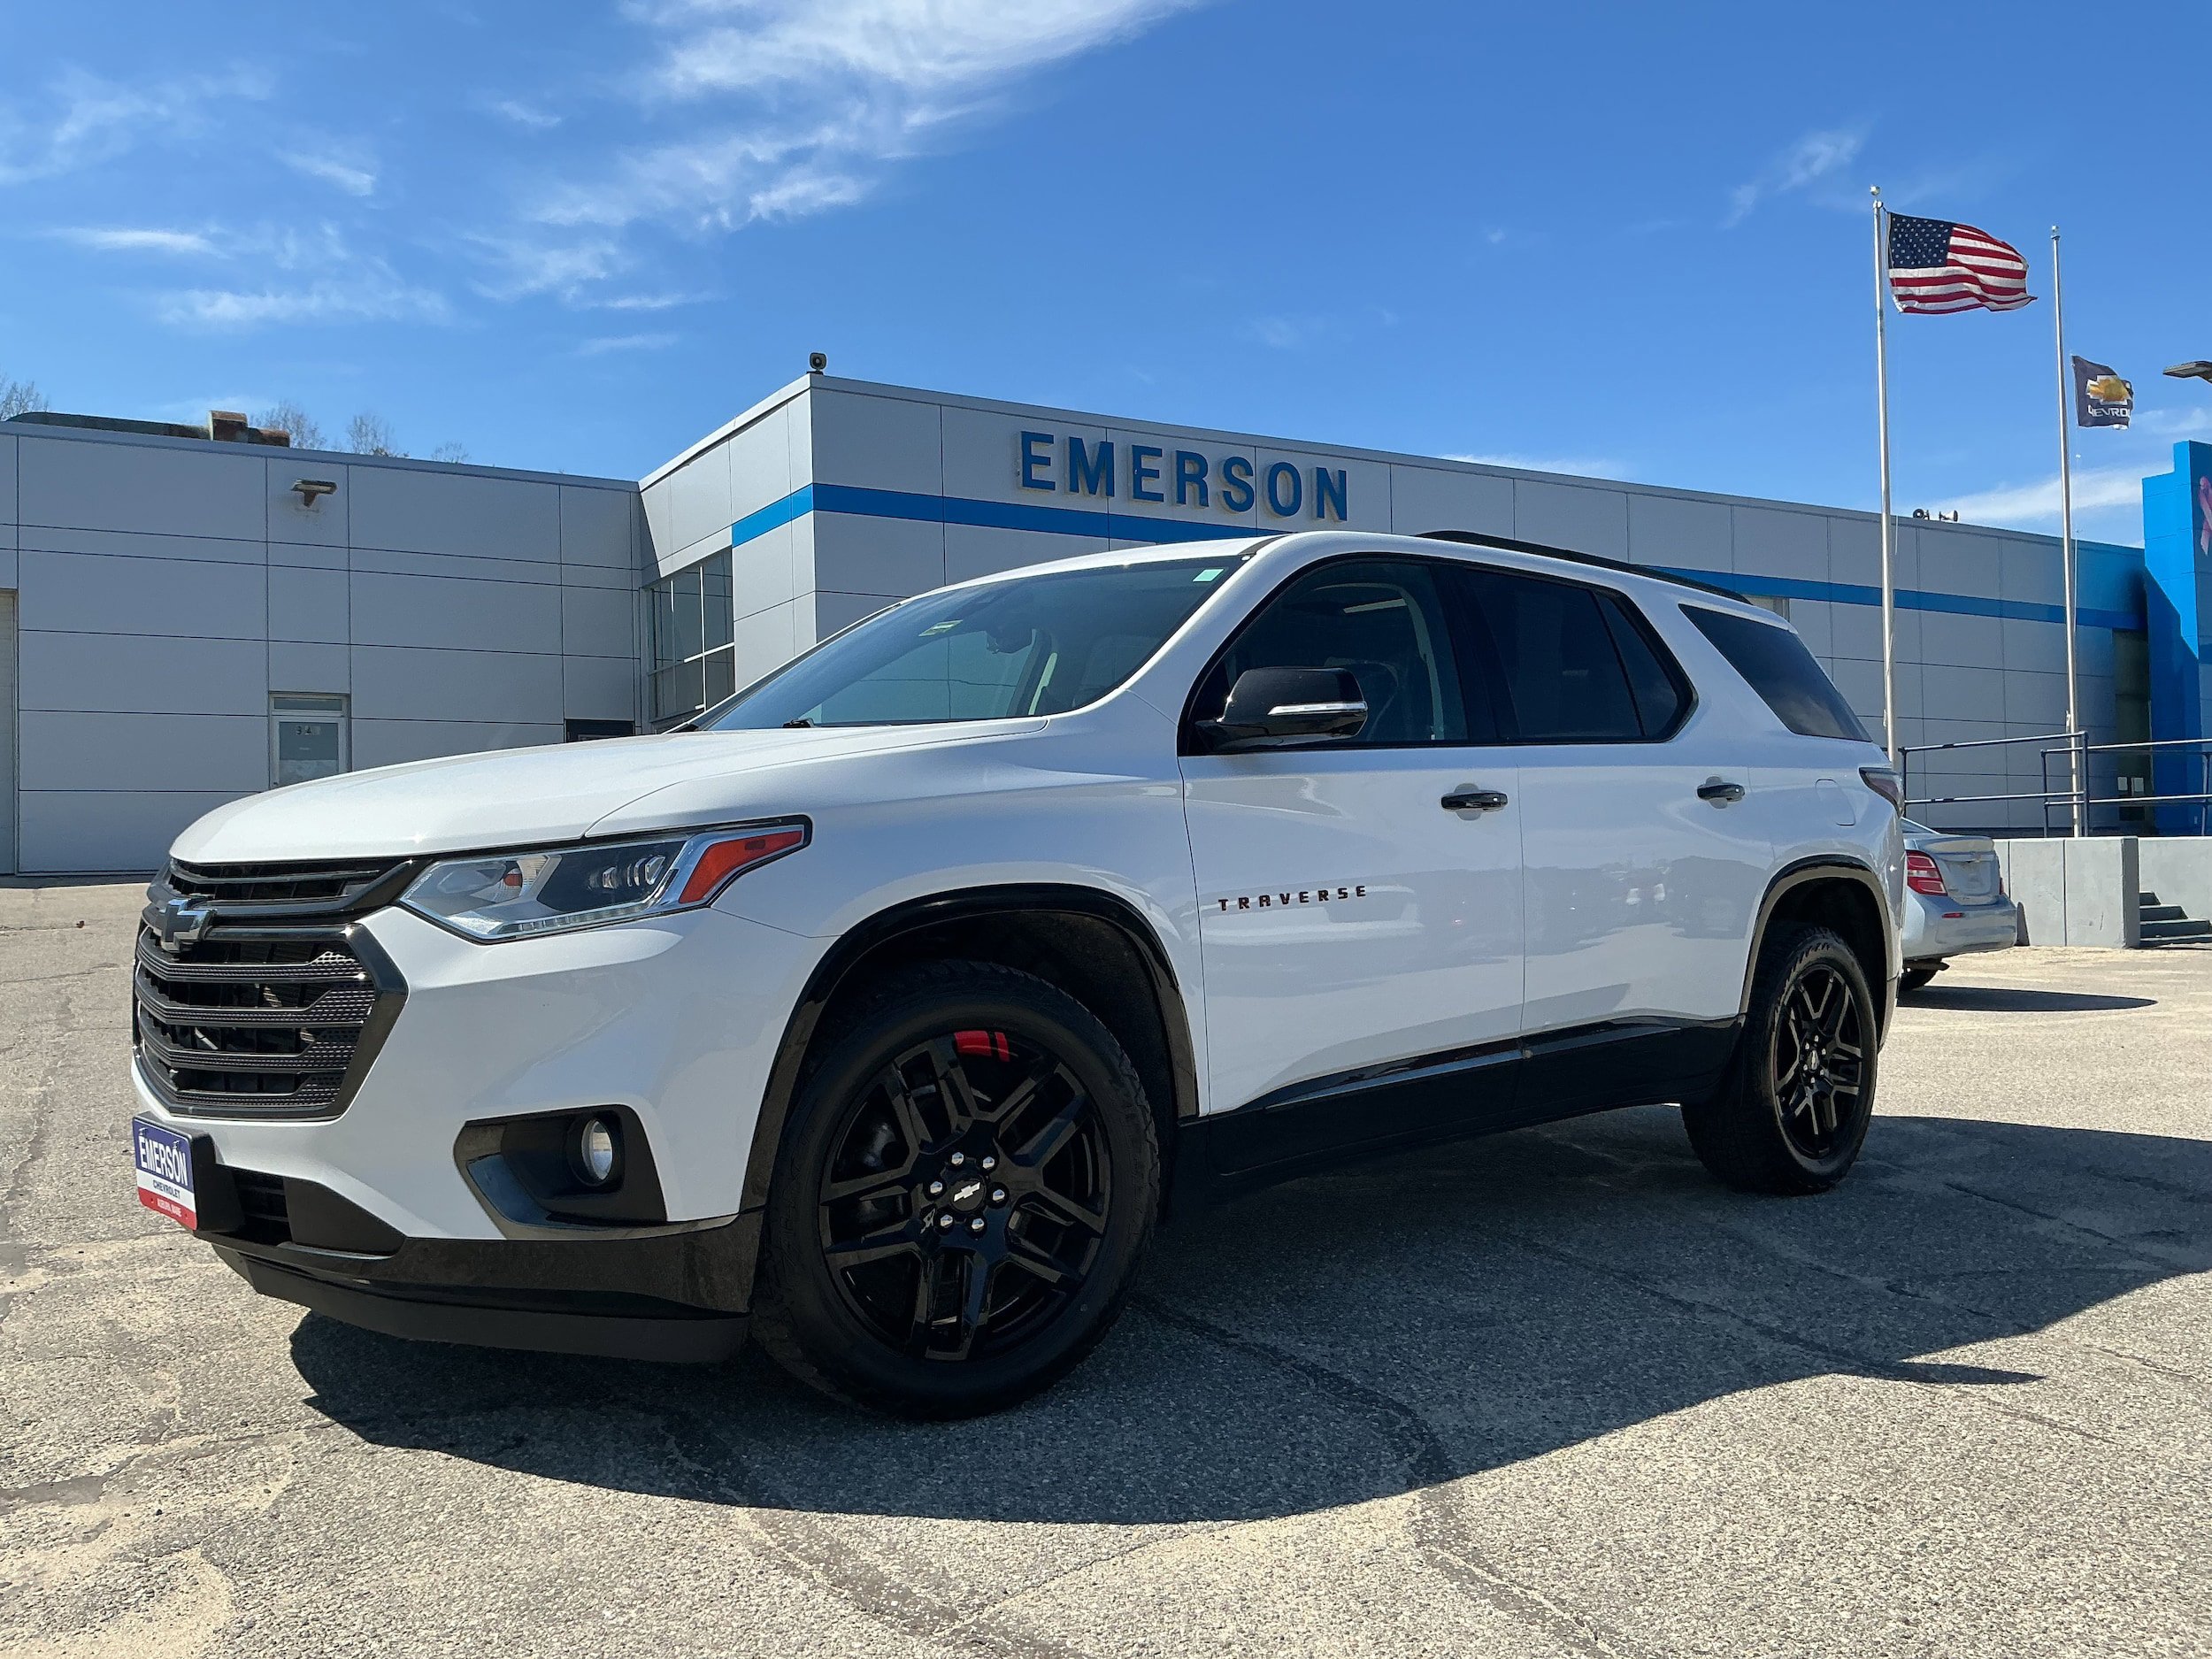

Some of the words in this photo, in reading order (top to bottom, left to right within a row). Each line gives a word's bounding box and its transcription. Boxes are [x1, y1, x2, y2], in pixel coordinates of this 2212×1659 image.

[1020, 431, 1348, 522] EMERSON
[1218, 886, 1366, 910] TRAVERSE
[139, 1136, 188, 1187] EMERSON
[153, 1179, 180, 1199] CHEVROLET
